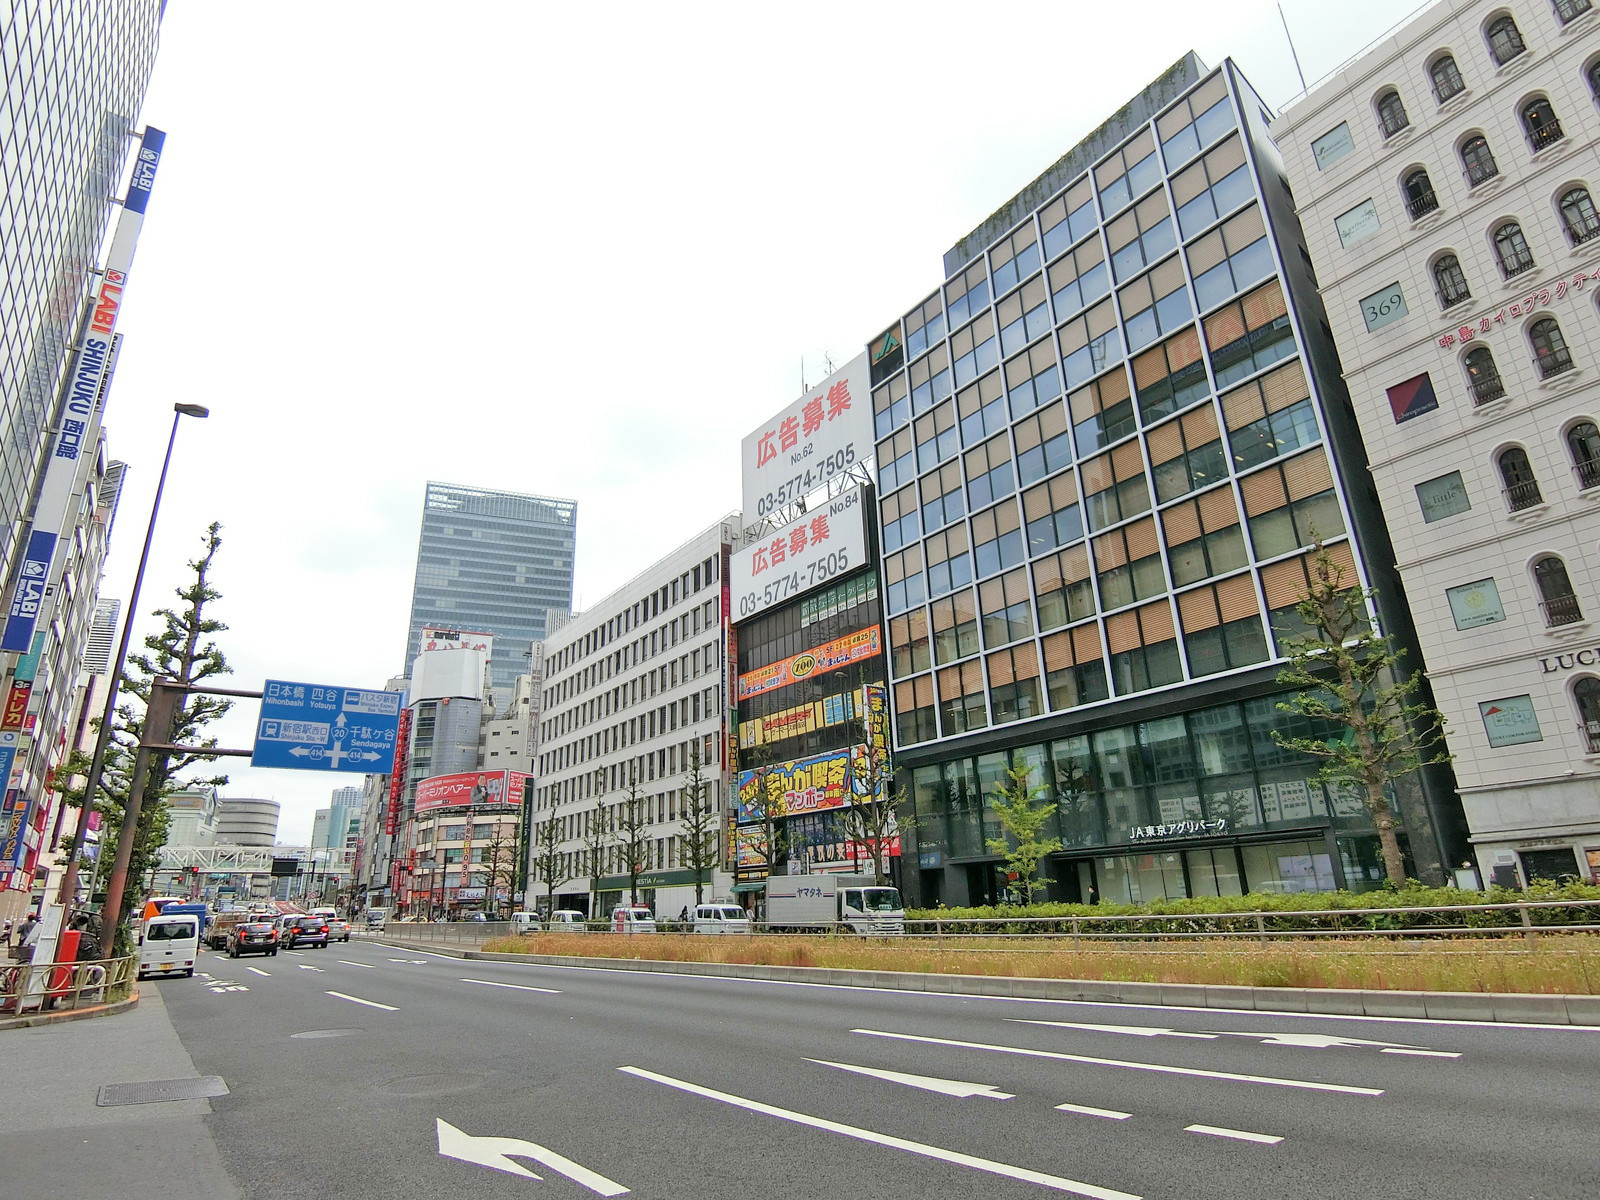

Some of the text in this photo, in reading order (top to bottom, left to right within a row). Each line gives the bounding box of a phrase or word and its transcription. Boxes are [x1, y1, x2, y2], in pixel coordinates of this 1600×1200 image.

[137, 162, 157, 192] LABI
[91, 282, 122, 335] LABI
[1366, 294, 1402, 323] 369
[69, 338, 107, 416] SHINJUKU
[1397, 400, 1438, 421] chiropractic
[757, 378, 852, 469] 広告募集
[55, 418, 86, 460] 西口館
[791, 443, 814, 465] No.62
[757, 442, 855, 517] 03-5774-7505
[829, 491, 859, 517] No.84
[1432, 491, 1457, 504] little
[752, 513, 830, 577] 広告募集
[740, 547, 849, 617] 03-5774-7505
[19, 580, 44, 619] LABI
[795, 660, 813, 673] ZOO
[15, 681, 31, 689] 3F
[268, 683, 305, 699] 日本橋
[312, 688, 338, 702] 四谷
[6, 690, 27, 724] トレカ
[265, 697, 304, 708] Nihonbashi
[310, 701, 336, 711] Yotsuya
[283, 722, 328, 736] 新宿駅西口
[763, 708, 812, 731] GAMERS
[281, 733, 304, 741] Shinjuku
[335, 729, 345, 738] 20
[350, 725, 396, 741] 千駄ケ谷
[311, 749, 322, 757] 414
[350, 751, 361, 759] 414
[351, 739, 391, 750] Sendagaya
[766, 757, 848, 802] まんが喫茶
[785, 789, 825, 809] マンボー
[1130, 818, 1226, 839] JA東京アグリパーク
[796, 887, 823, 898] ヤマタネ
